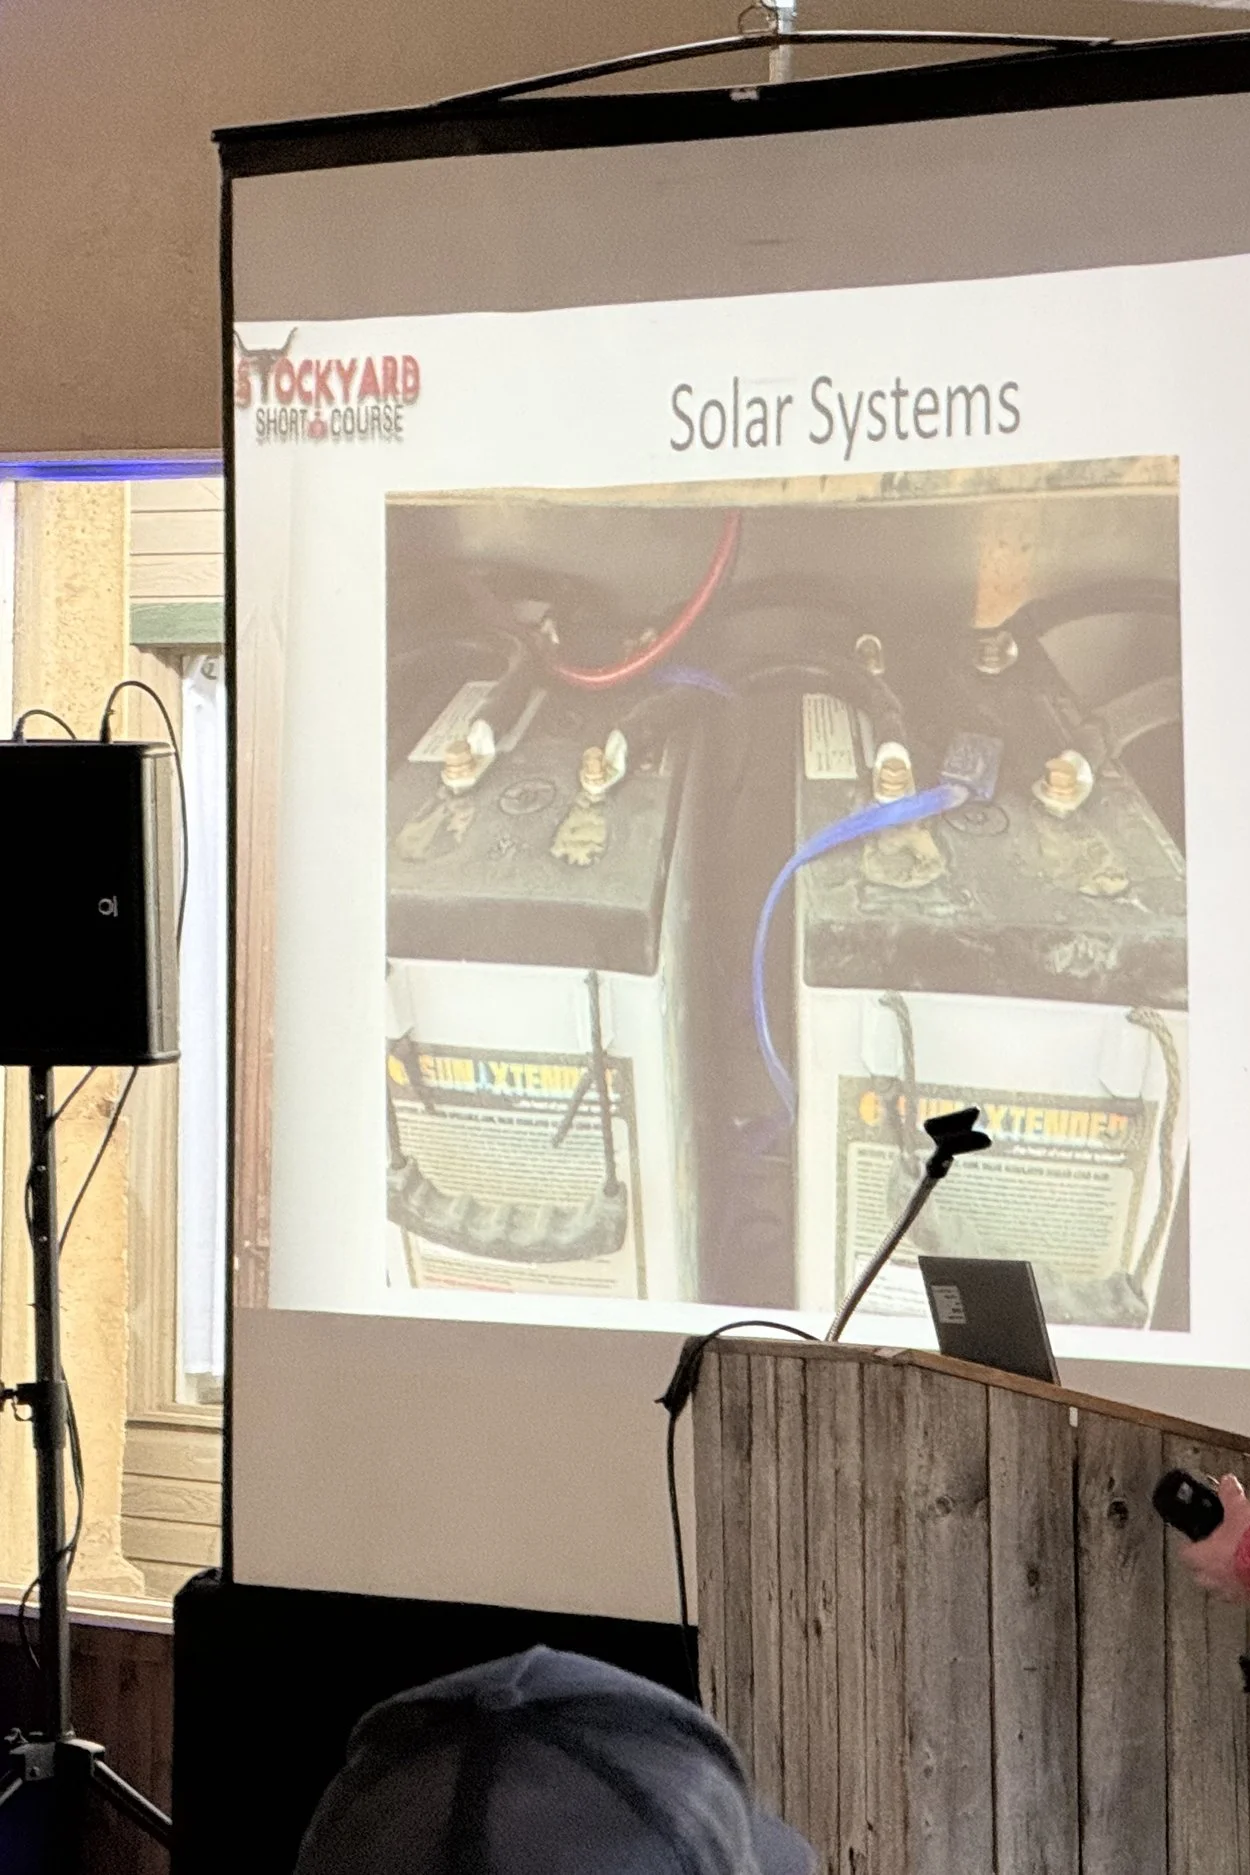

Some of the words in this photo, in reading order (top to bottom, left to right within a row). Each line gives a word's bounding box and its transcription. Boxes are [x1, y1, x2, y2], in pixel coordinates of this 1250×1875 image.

[236, 354, 420, 409] STOCKYARD
[256, 408, 307, 436] SHORT
[331, 404, 404, 436] COURSE
[670, 376, 793, 451] Solar
[809, 375, 1021, 461] Systems
